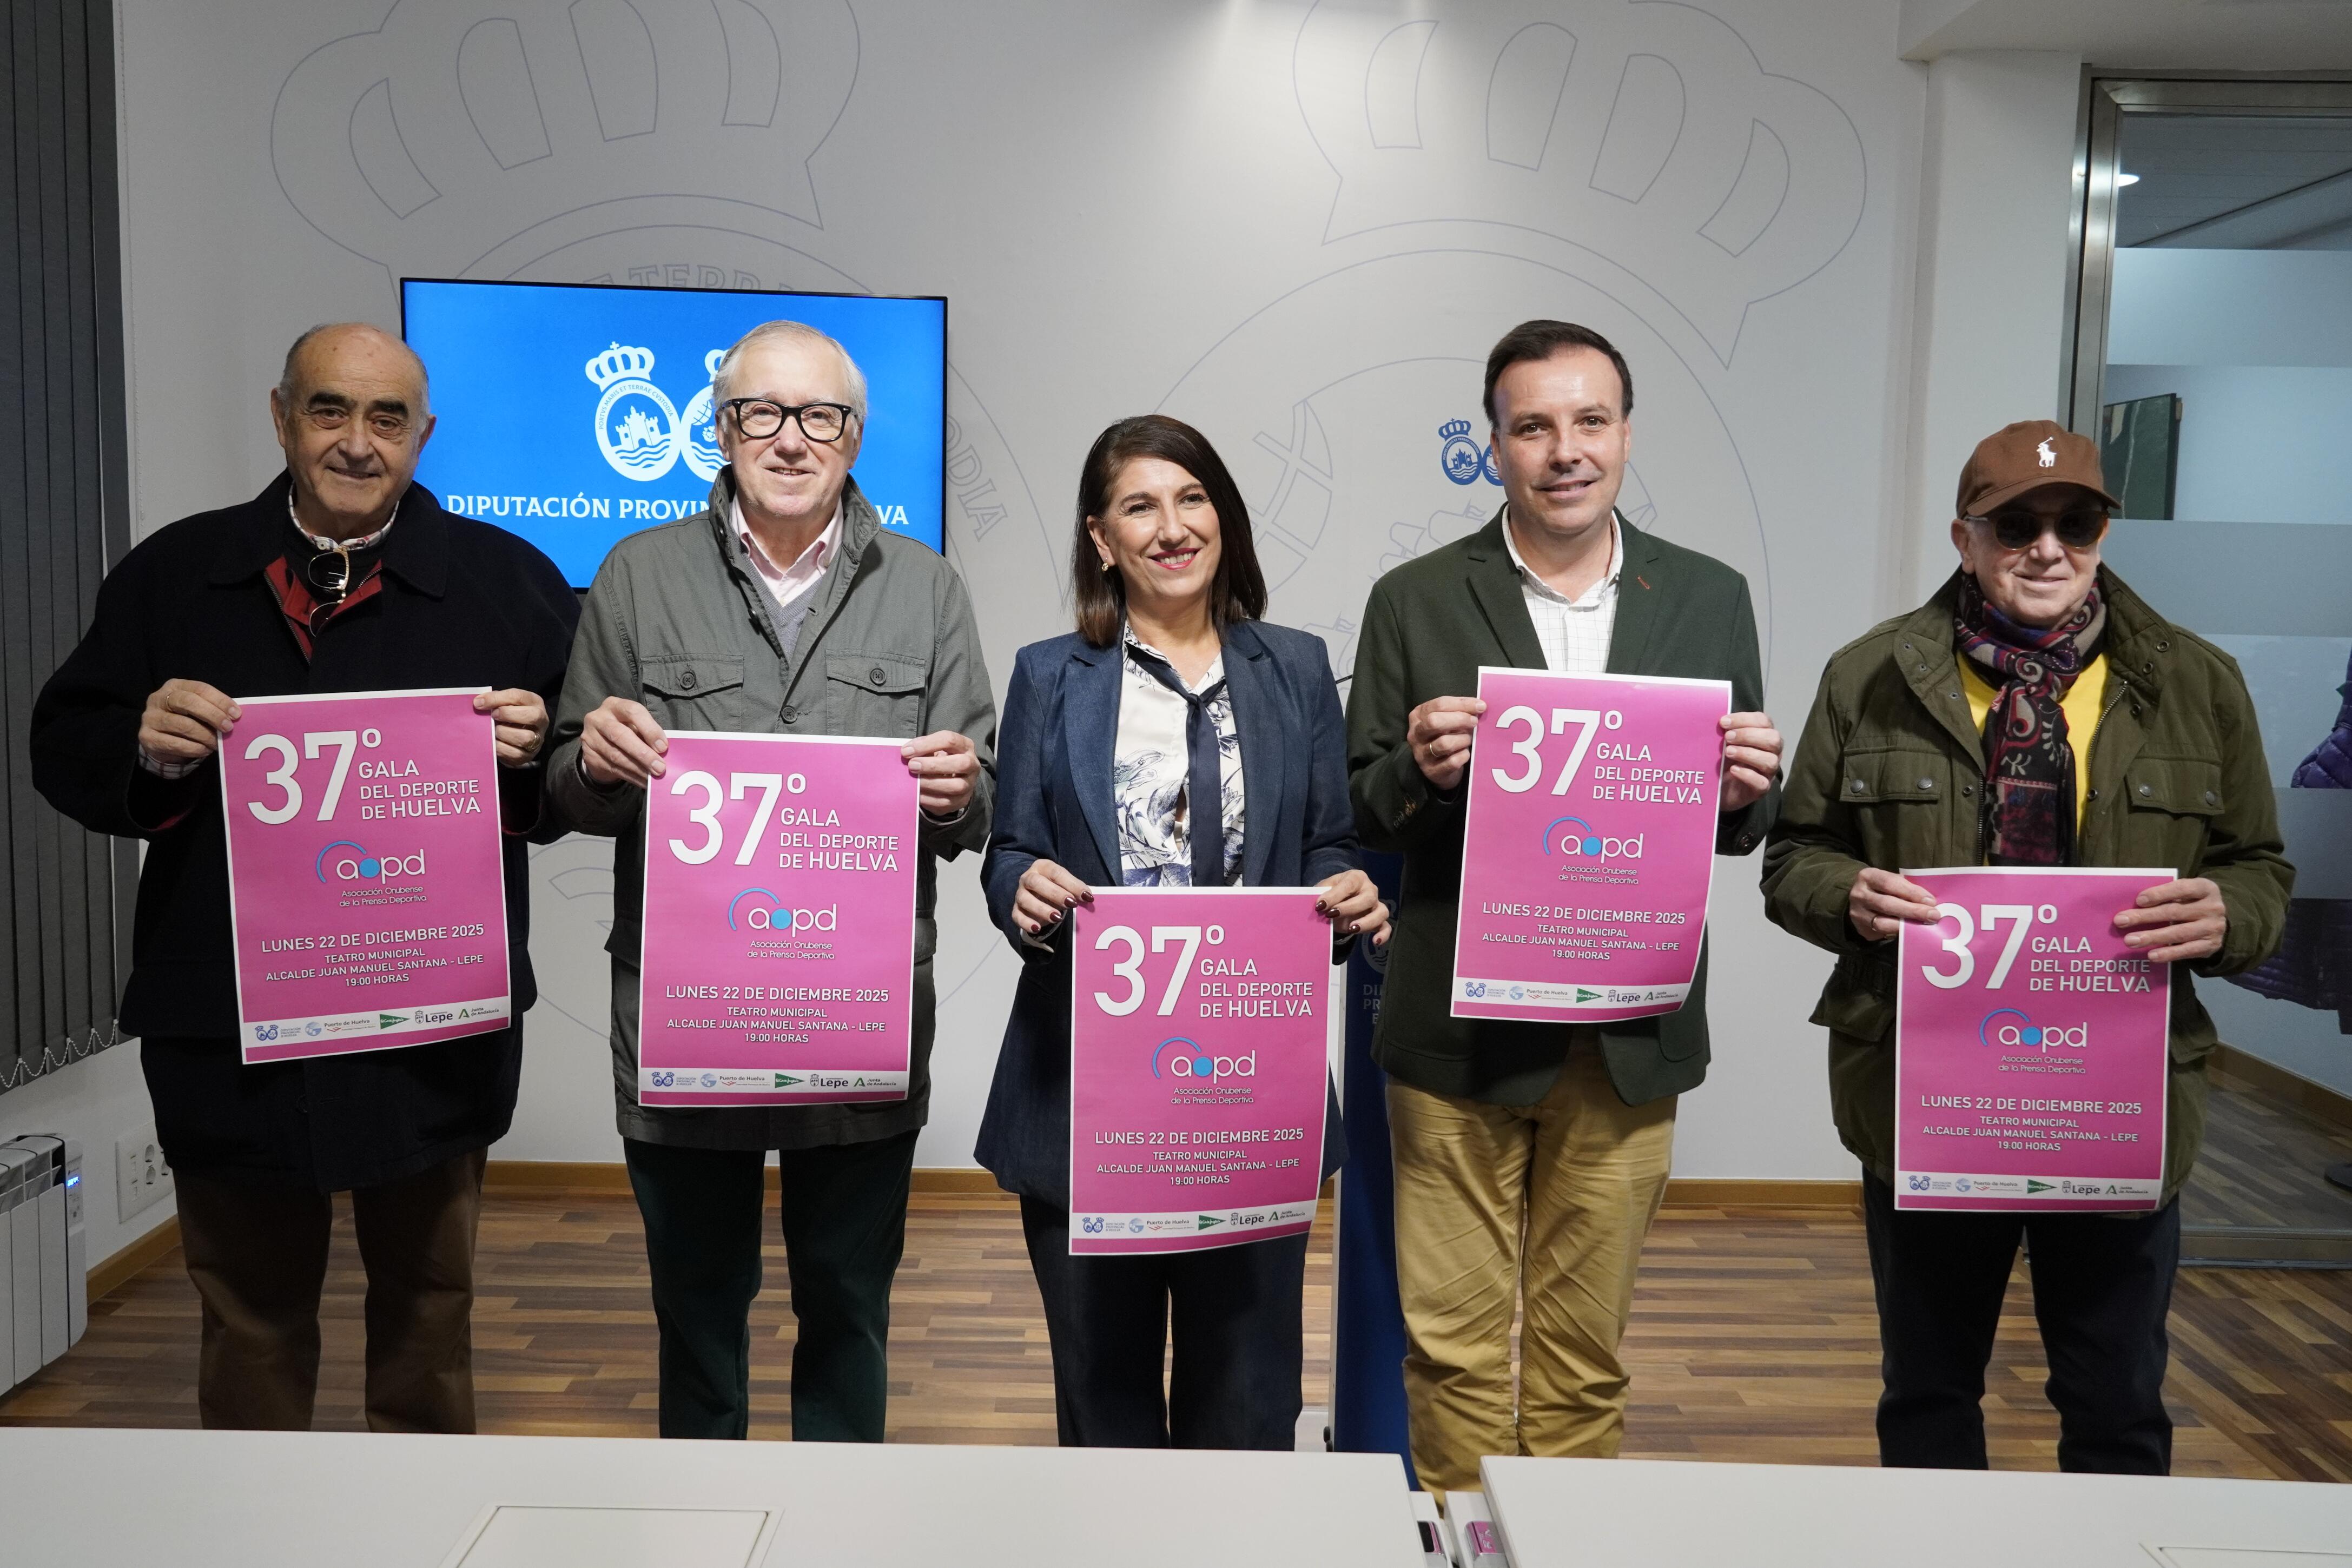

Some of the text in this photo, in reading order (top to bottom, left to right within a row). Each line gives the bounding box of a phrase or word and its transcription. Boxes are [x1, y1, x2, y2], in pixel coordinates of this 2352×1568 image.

[447, 492, 610, 518] DIPUTACIÓN
[1597, 743, 1651, 761] GALA
[359, 760, 419, 778] GALA
[1595, 766, 1704, 784] DEL DEPORTE
[361, 780, 479, 799] DEL DEPORTE
[1593, 785, 1701, 804] DE HUELVA
[362, 797, 480, 819] DE HUELVA
[781, 808, 840, 826] GALA
[781, 833, 898, 850] DEL DEPORTE
[780, 852, 897, 871] DE HUELVA
[1562, 865, 1600, 873] Asociación
[1605, 876, 1639, 884] Deportiva
[342, 888, 383, 898] Asociación
[389, 895, 426, 904] Deportiva
[1483, 902, 1684, 924] LUNES 22 DE DICIEMBRE 2025
[262, 924, 483, 952] LUNES 22 DE DICIEMBRE 2025
[1537, 924, 1628, 937] TEATRO MUNICIPAL
[750, 941, 791, 949] Asociación
[1483, 933, 1527, 943] ALCALDE
[1529, 936, 1555, 945] JUAN
[1558, 938, 1598, 947] MANUEL
[1601, 941, 1646, 949] SANTANA
[2032, 937, 2091, 952] GALA
[325, 948, 425, 963] TEATRO MUNICIPAL
[797, 951, 834, 960] Deportiva
[1578, 951, 1610, 960] HORAS
[267, 955, 483, 981] ALCALDE JUAN MANUEL SANTANA LEPE
[1201, 959, 1257, 975] GALA
[2031, 960, 2150, 972] DEL DEPORTE
[346, 974, 409, 986] 19:00 HORAS
[2030, 976, 2150, 992] DE HUELVA
[667, 986, 888, 1001] LUNES 22 DE DICIEMBRE 2025
[1201, 982, 1313, 997] DEL DEPORTE
[1617, 994, 1640, 1003] Lepe
[727, 1007, 827, 1017] TEATRO MUNICIPAL
[1200, 1000, 1313, 1017] DE HUELVA
[426, 1012, 453, 1023] Lepe
[668, 1019, 716, 1028] ALCALDE
[719, 1020, 747, 1028] JUAN
[751, 1021, 795, 1029] MANUEL
[798, 1021, 848, 1030] SANTANA
[774, 1034, 808, 1042] HORAS
[821, 1078, 848, 1088] Lepe
[1922, 1095, 2141, 1114] LUNES 22 DE DICIEMBRE 2025
[1980, 1116, 2079, 1127] TEATRO MUNICIPAL
[1096, 1128, 1303, 1143] LUNES 22 DE DICIEMBRE 2025
[1923, 1126, 2138, 1141] ALCALDE JUAN MANUEL SANTANA LEPE
[1998, 1141, 2060, 1150] 19:00 HORAS
[1194, 1150, 1247, 1159] MUNICIPAL
[1097, 1159, 1299, 1173] ALCALDE JUAN MANUEL SANTANA LEPE
[1197, 1175, 1230, 1184] HORAS
[2072, 1186, 2100, 1195] Lepe
[1240, 1215, 1264, 1225] Lepe
